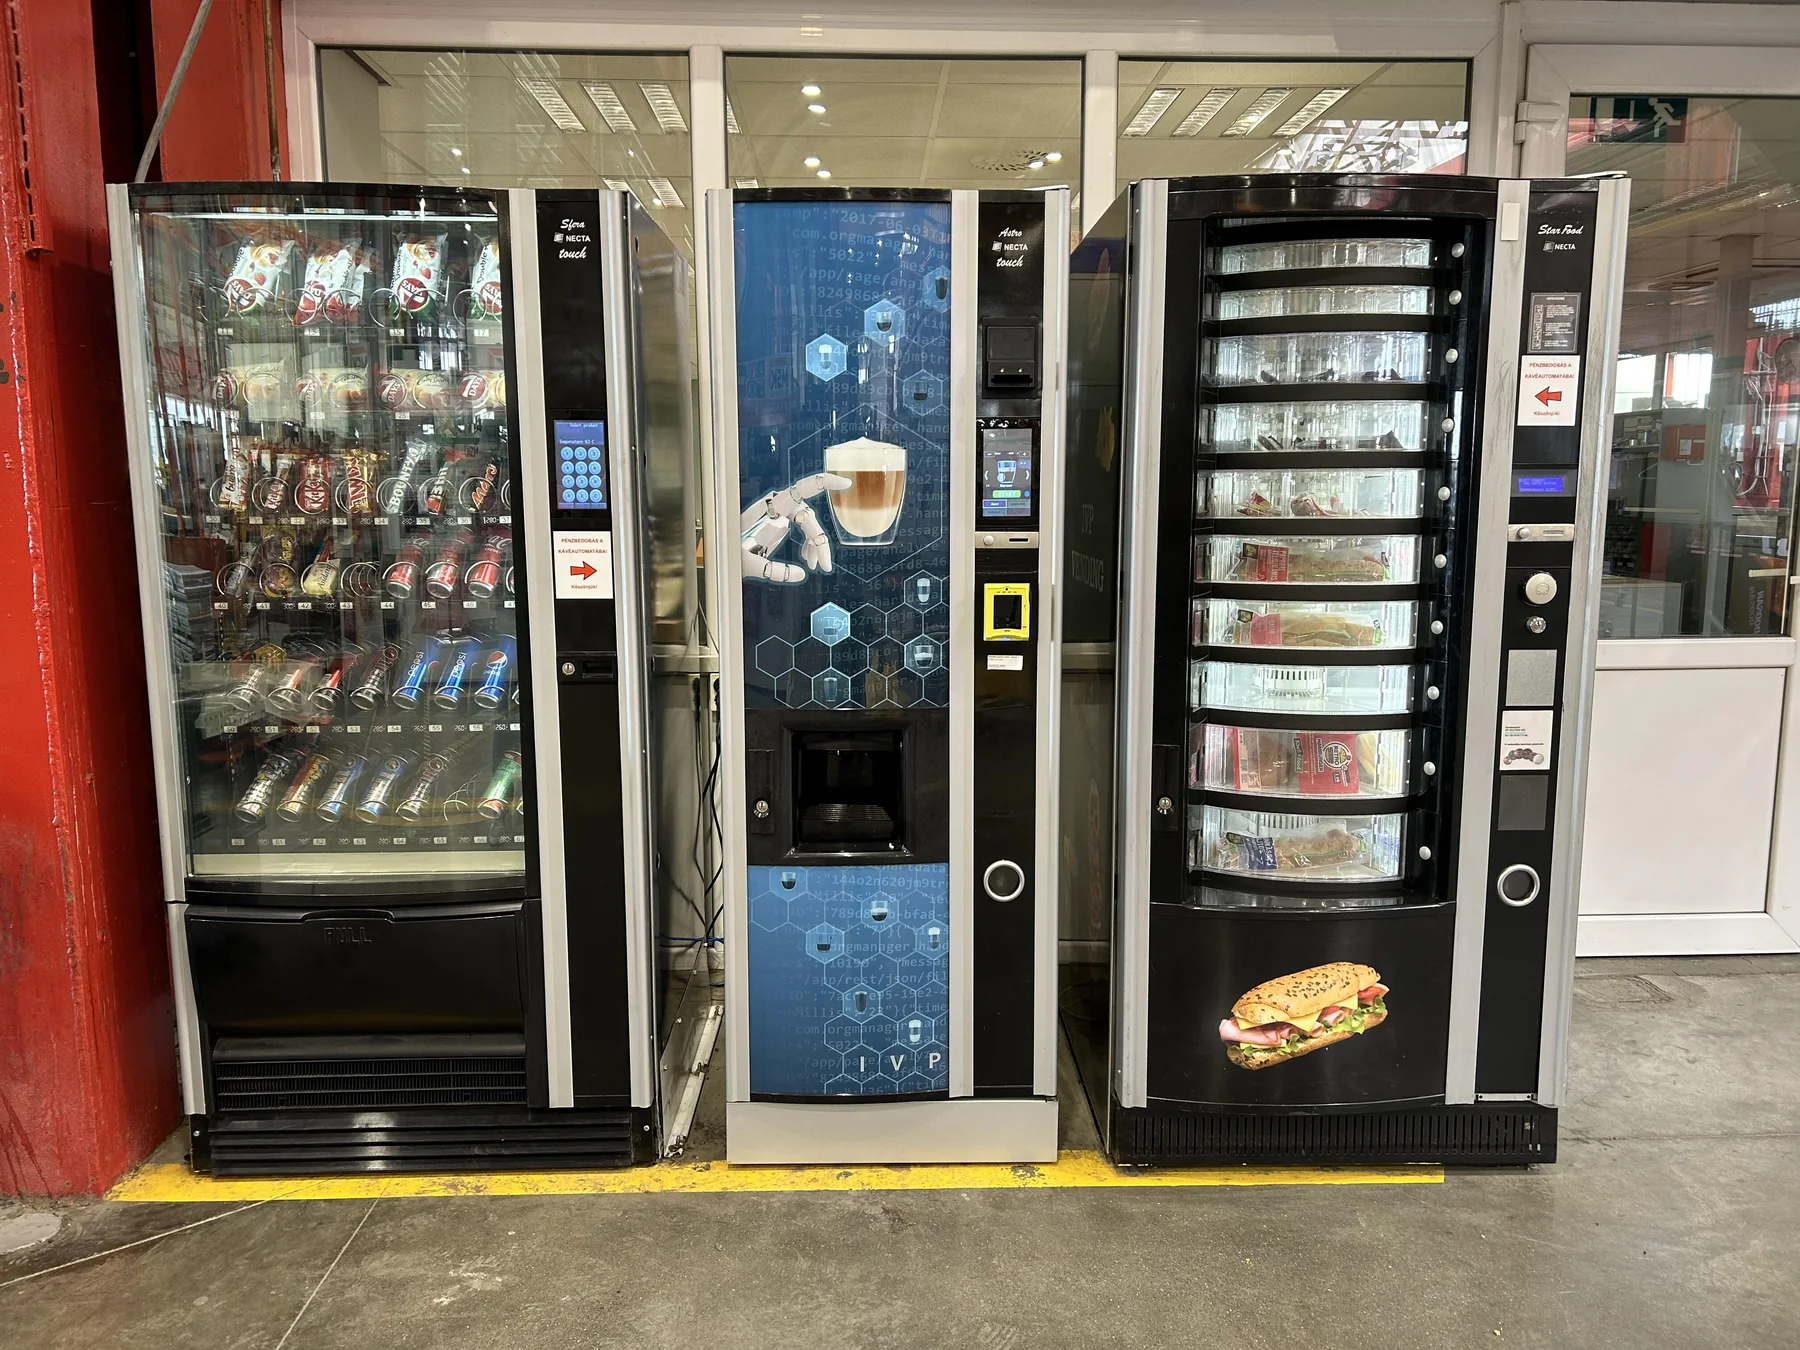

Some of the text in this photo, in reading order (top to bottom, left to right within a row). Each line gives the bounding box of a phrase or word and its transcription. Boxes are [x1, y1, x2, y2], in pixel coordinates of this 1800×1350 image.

[560, 218, 586, 231] Sfera
[1537, 224, 1584, 235] Star Food
[565, 234, 591, 242] NECTA
[1003, 243, 1028, 251] NECTA
[558, 246, 587, 259] touch
[996, 254, 1024, 267] touch
[469, 376, 484, 397] DAYS
[1081, 503, 1094, 535] IVP
[1071, 549, 1105, 593] VENDING
[407, 651, 425, 677] pepsi
[451, 651, 467, 678] pepsi
[1333, 745, 1341, 766] RETRO
[323, 926, 373, 945] PULL
